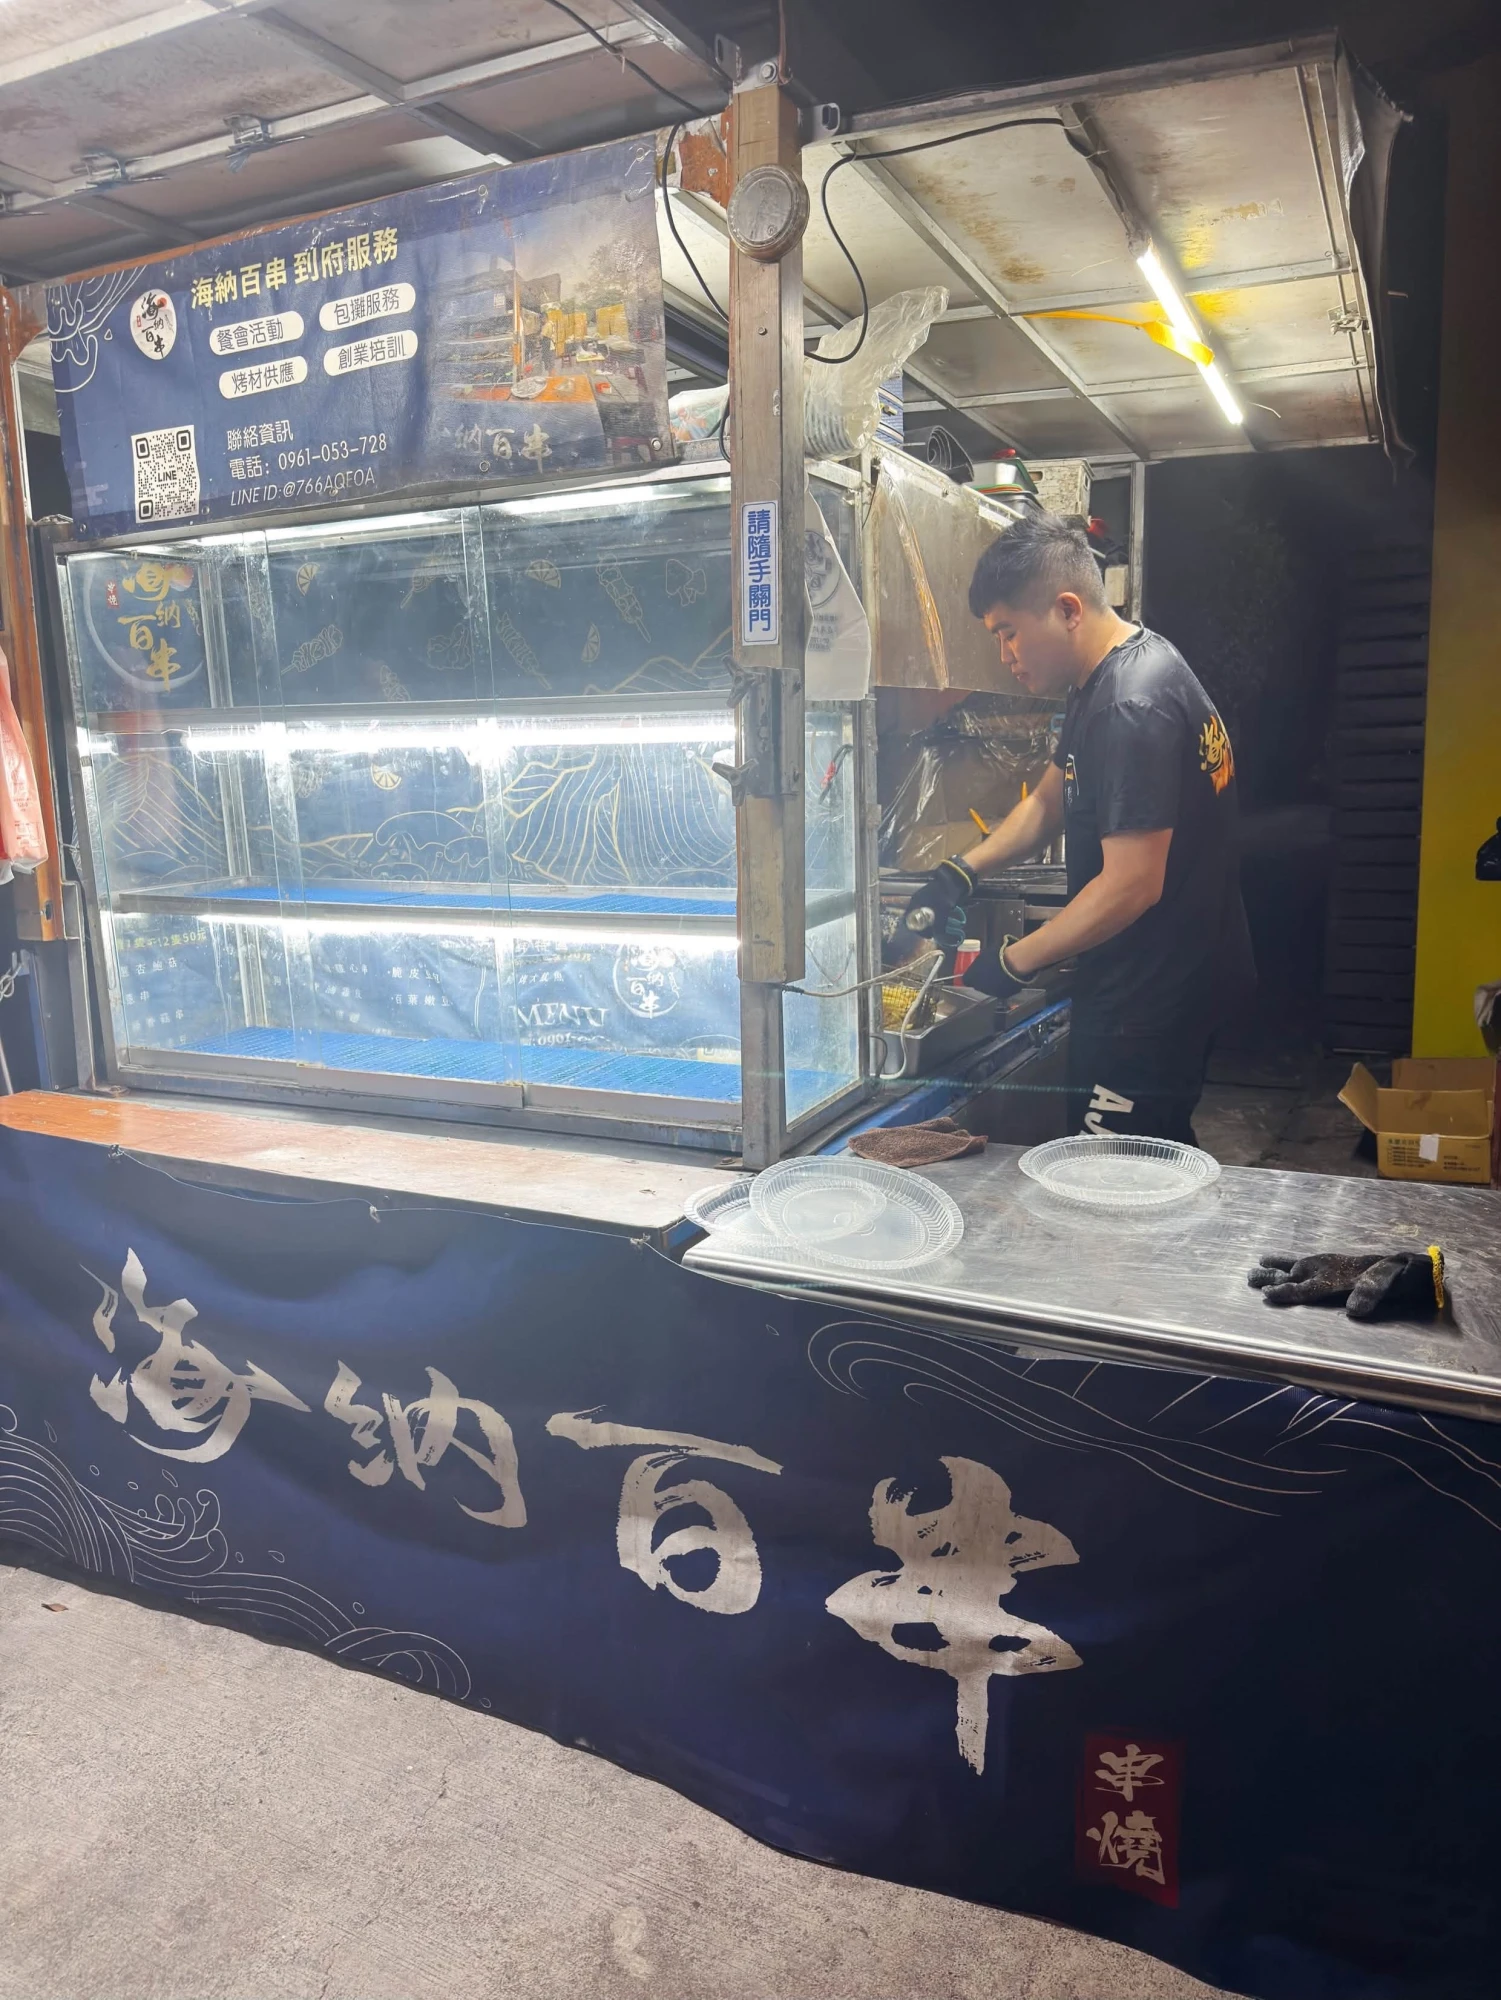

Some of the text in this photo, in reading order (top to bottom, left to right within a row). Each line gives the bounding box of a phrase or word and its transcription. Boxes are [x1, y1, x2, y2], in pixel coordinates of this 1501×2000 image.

[191, 226, 398, 310] 海納百串 到府服務
[333, 288, 400, 326] 包攤服務
[216, 317, 283, 352] 餐會活動
[337, 335, 407, 370] 創業培訓
[230, 361, 295, 395] 烤材供應
[226, 419, 294, 452] 聯絡資訊
[278, 433, 387, 471] 0961-053-728
[158, 471, 177, 482] LINE
[230, 487, 260, 507] LINE
[747, 508, 772, 632] 請隨手關門
[509, 1002, 611, 1028] MENU
